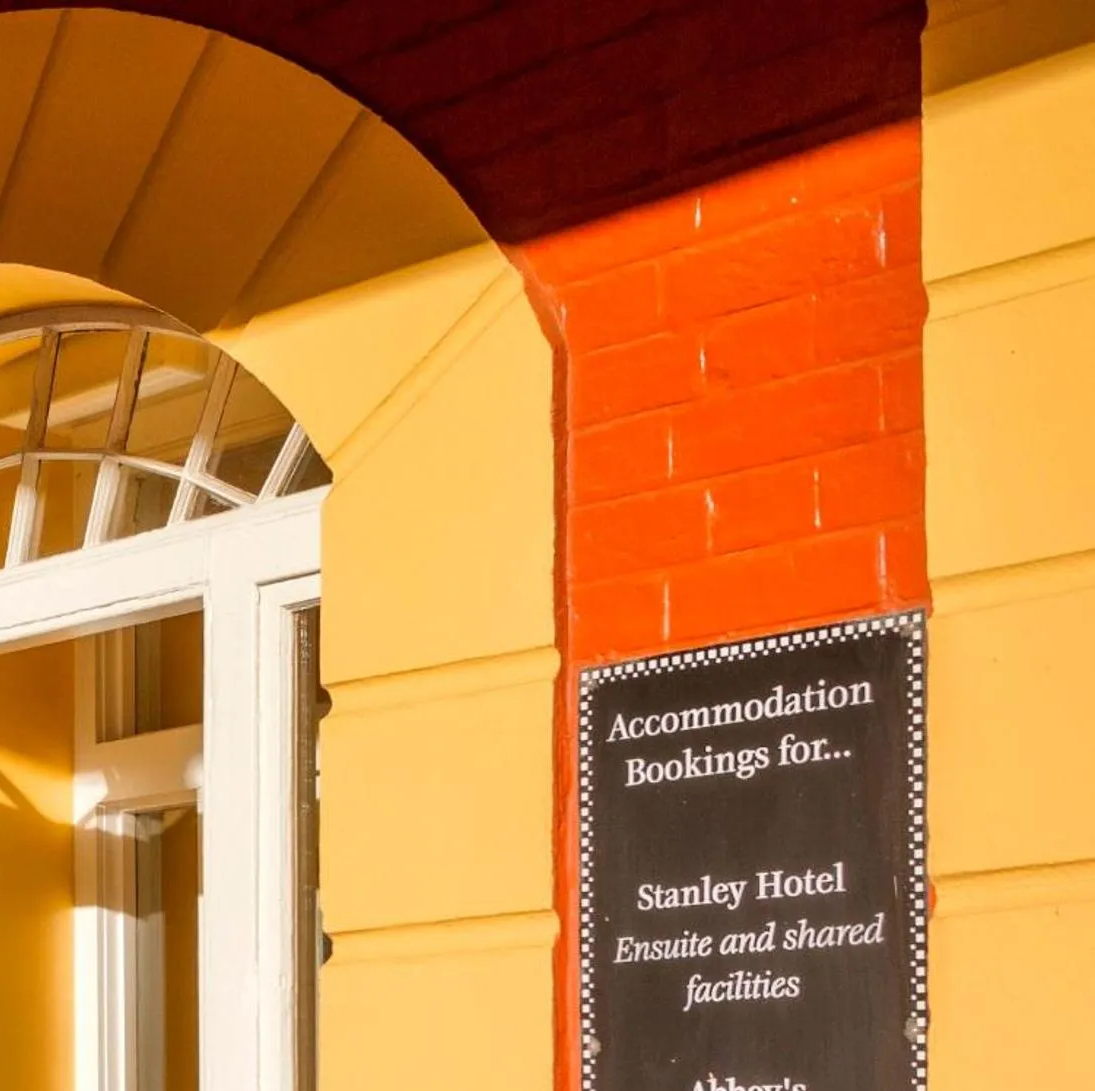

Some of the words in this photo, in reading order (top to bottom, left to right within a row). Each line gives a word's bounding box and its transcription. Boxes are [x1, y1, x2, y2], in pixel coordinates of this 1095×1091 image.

[605, 679, 874, 742] Accommodation
[624, 745, 770, 787] Bookings
[777, 733, 851, 766] for...
[637, 876, 747, 911] Stanley
[756, 863, 847, 900] Hotel
[613, 930, 712, 964] Ensuite
[719, 922, 776, 955] and
[783, 913, 886, 951] shared
[683, 973, 801, 1012] facilities
